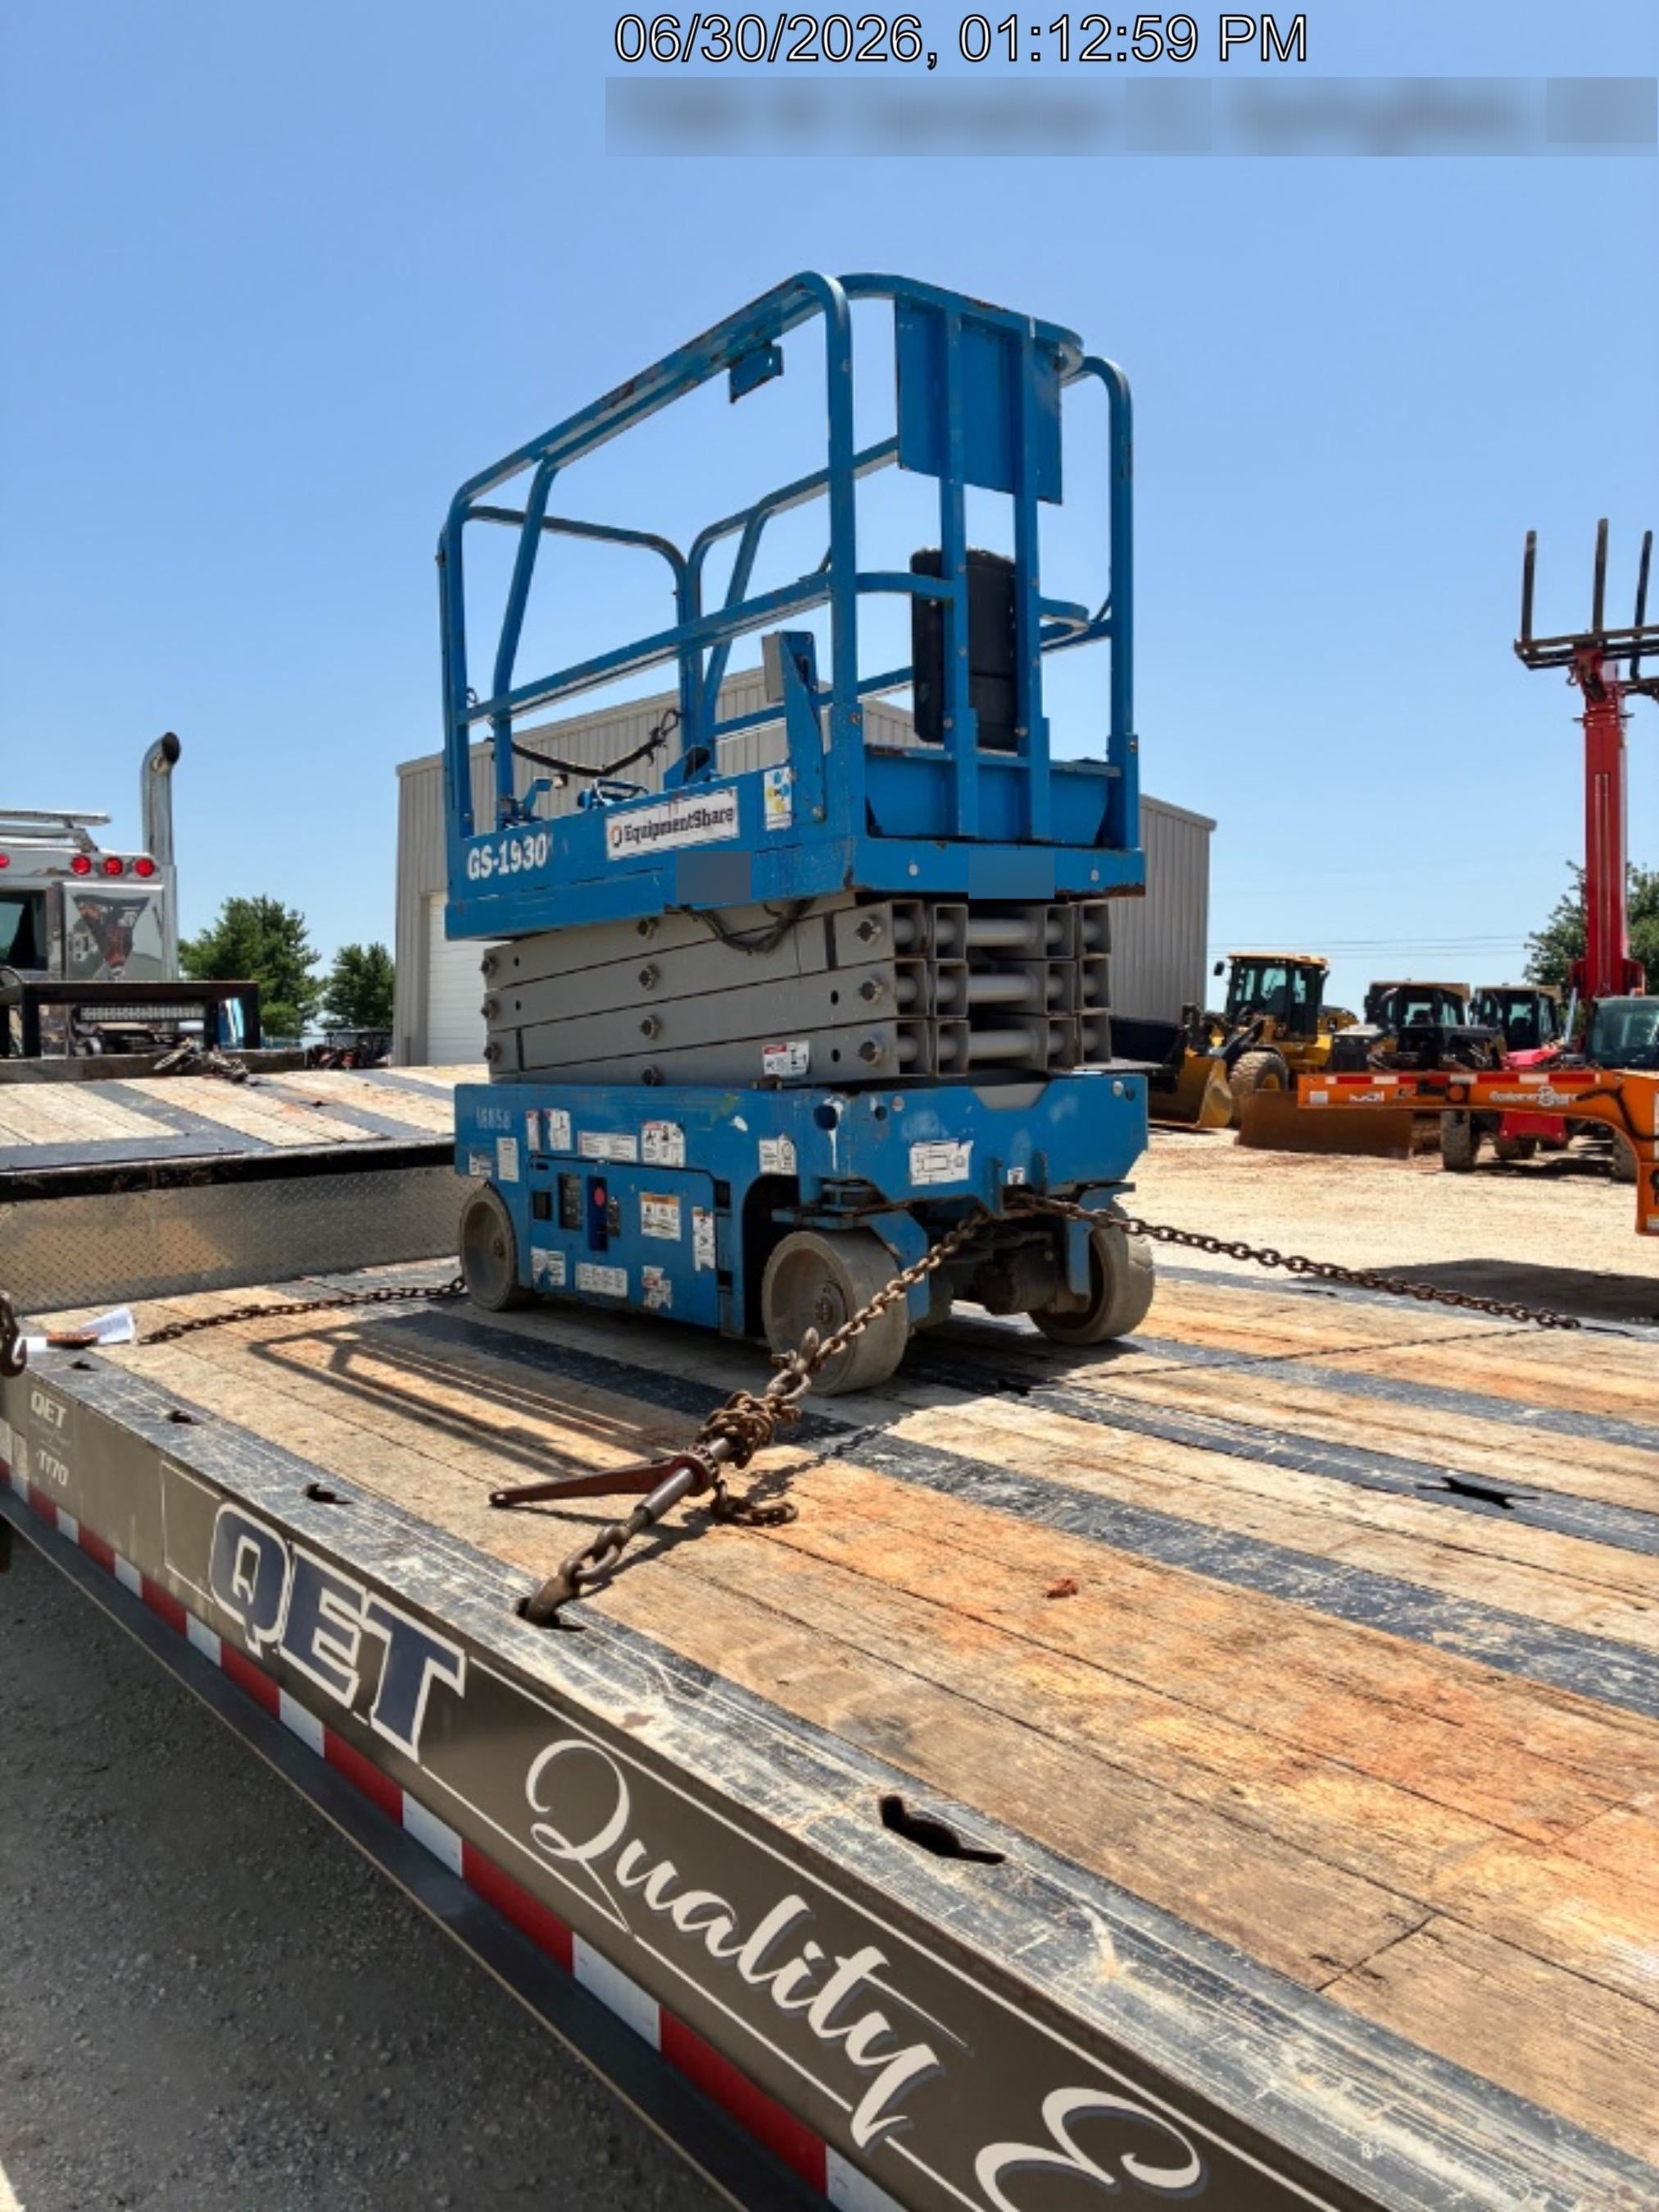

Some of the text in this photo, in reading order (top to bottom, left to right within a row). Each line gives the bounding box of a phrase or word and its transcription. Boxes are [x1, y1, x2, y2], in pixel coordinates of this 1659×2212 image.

[468, 832, 547, 881] GS-1930
[623, 807, 734, 843] EquipmentShare
[210, 1503, 467, 1762] QET
[525, 1738, 975, 2150] Quality
